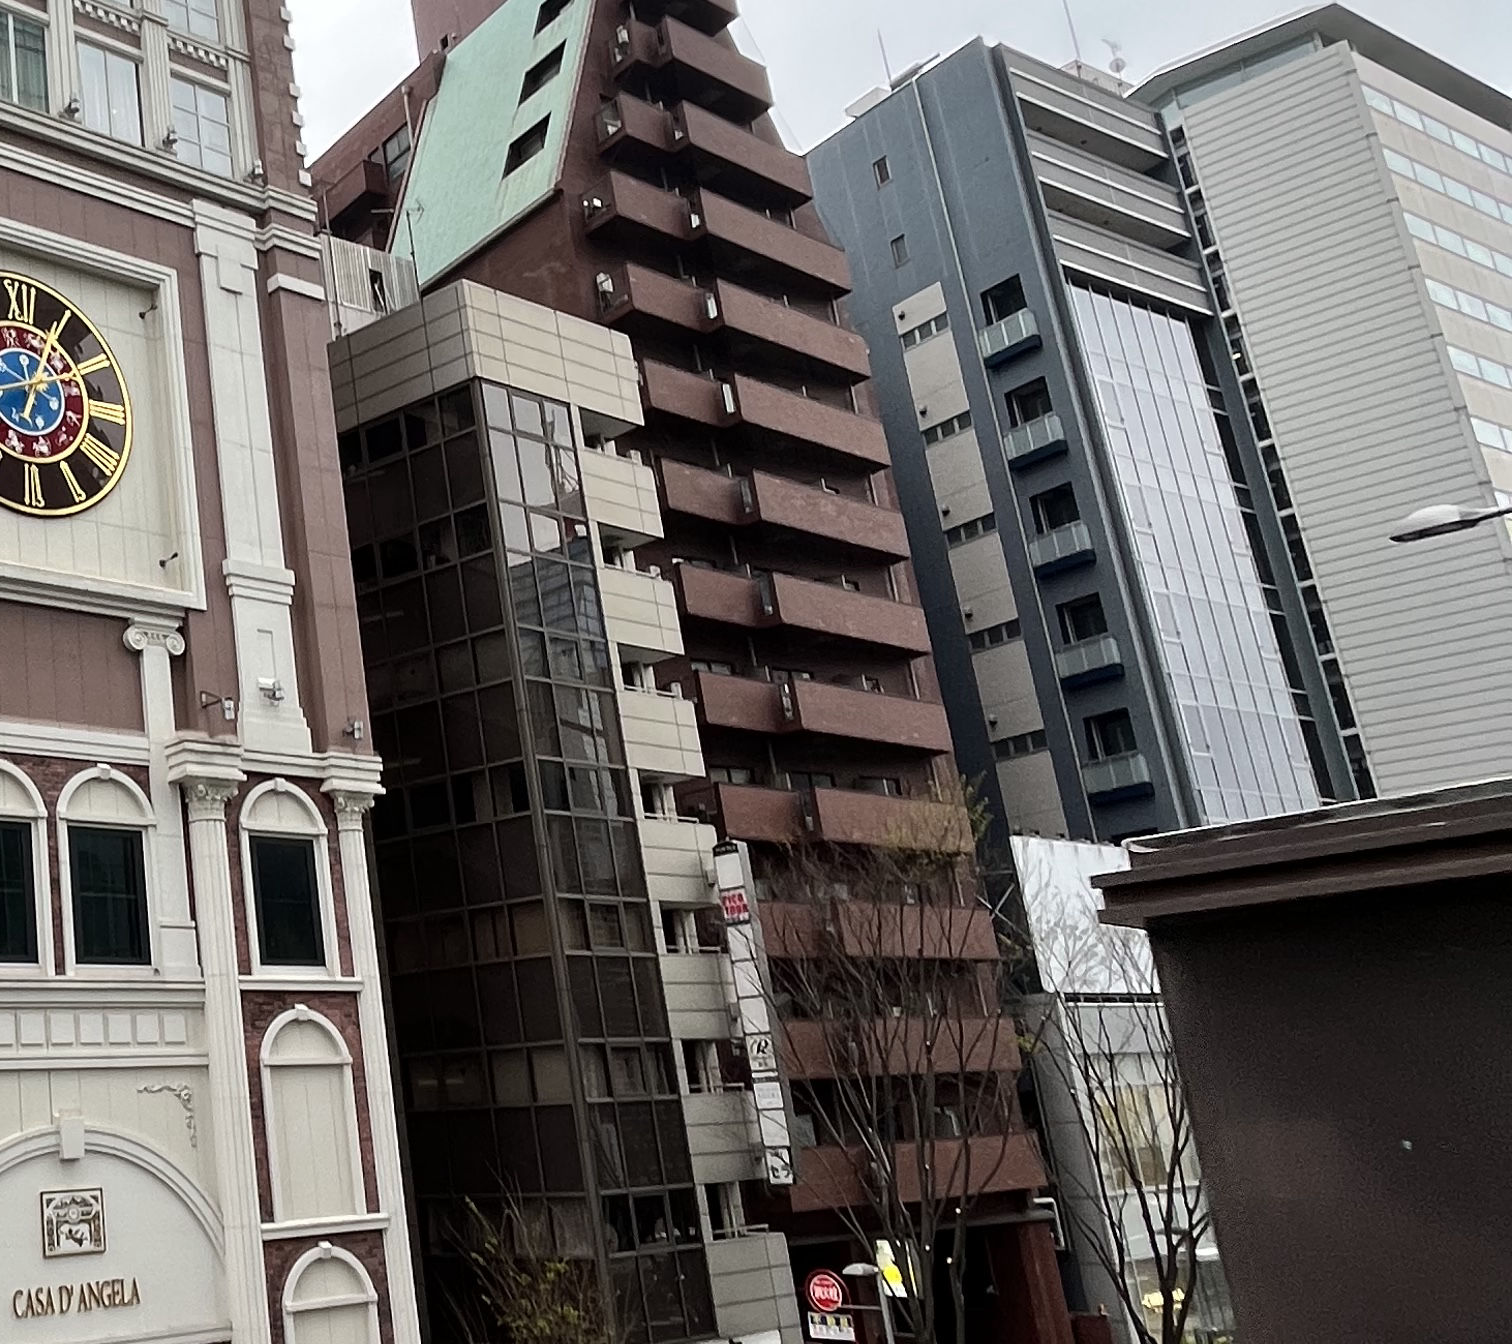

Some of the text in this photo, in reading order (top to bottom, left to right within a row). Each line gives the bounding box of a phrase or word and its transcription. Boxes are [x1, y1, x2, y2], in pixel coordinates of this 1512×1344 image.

[3, 278, 36, 323] XII
[77, 352, 111, 376] II
[88, 399, 126, 426] III
[13, 1287, 55, 1318] CASA
